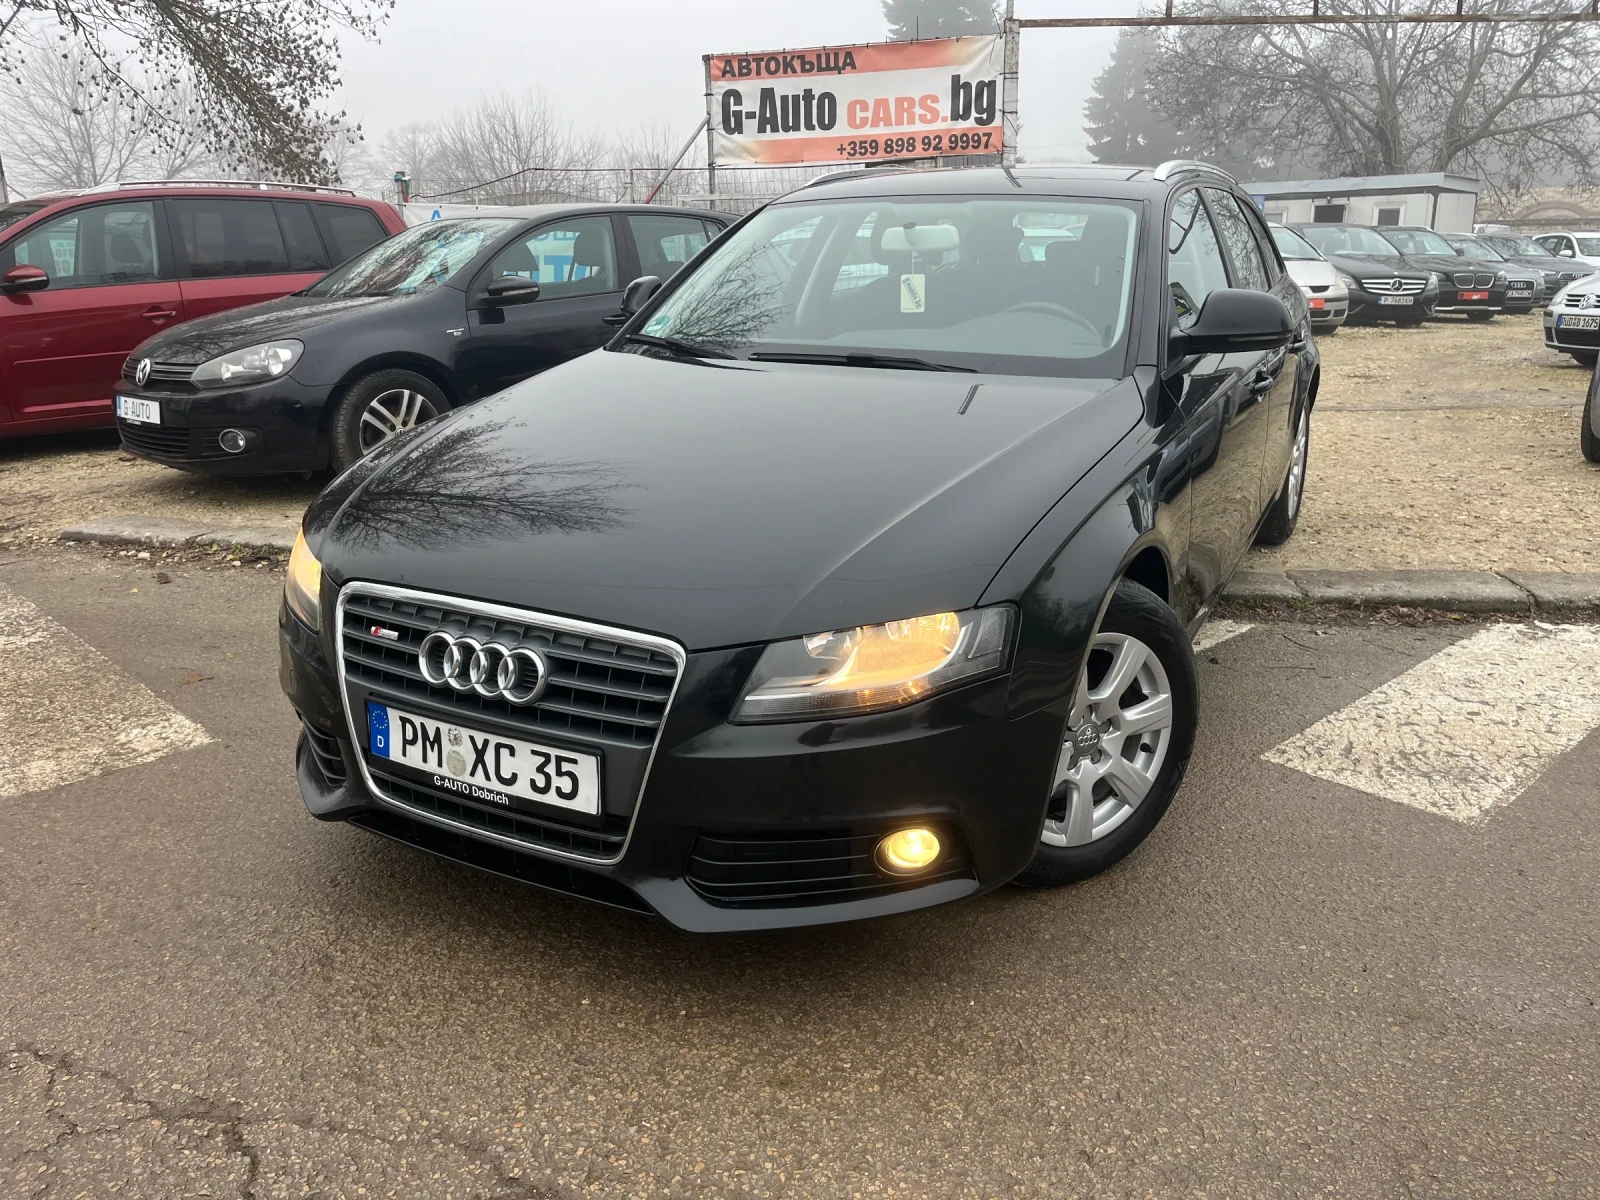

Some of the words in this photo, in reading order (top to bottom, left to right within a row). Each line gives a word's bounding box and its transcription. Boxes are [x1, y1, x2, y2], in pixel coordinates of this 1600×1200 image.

[721, 51, 857, 78] АВТОКЪЩА
[721, 87, 837, 135] G-Auto
[837, 139, 879, 157] +359
[883, 136, 916, 155] 898
[921, 134, 943, 152] 92
[948, 132, 992, 151] 9997
[1582, 317, 1599, 329] 1675
[123, 399, 151, 420] G-AUTO
[377, 735, 385, 748] D
[399, 715, 443, 768] PM
[468, 734, 518, 787] XC
[529, 749, 579, 801] 35
[433, 775, 469, 794] G-AUTO
[471, 786, 509, 805] Dobrich
